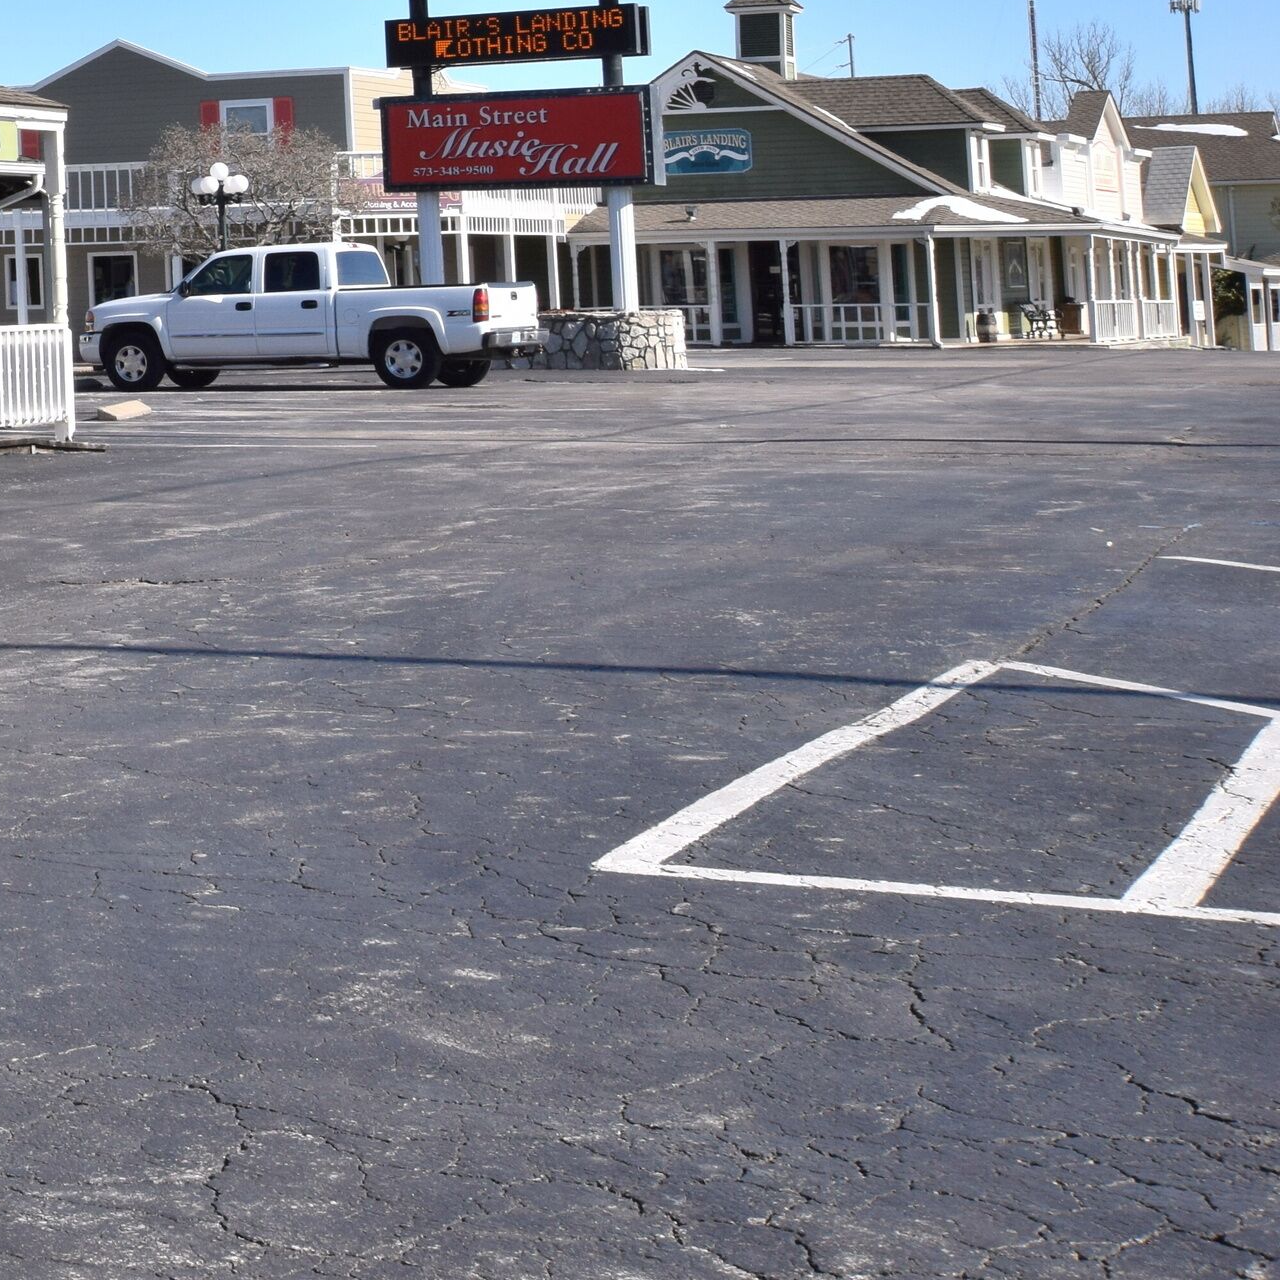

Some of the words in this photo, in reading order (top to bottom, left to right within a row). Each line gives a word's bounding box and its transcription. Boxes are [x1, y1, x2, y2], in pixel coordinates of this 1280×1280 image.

[397, 16, 500, 42] BLAIR'S
[515, 8, 624, 34] LANDING
[562, 30, 594, 50] CO
[406, 107, 468, 129] Main
[479, 105, 549, 127] Street
[419, 126, 541, 160] Music
[700, 134, 747, 149] LANDING
[413, 164, 494, 177] 573-348-9500
[519, 142, 620, 177] Hall
